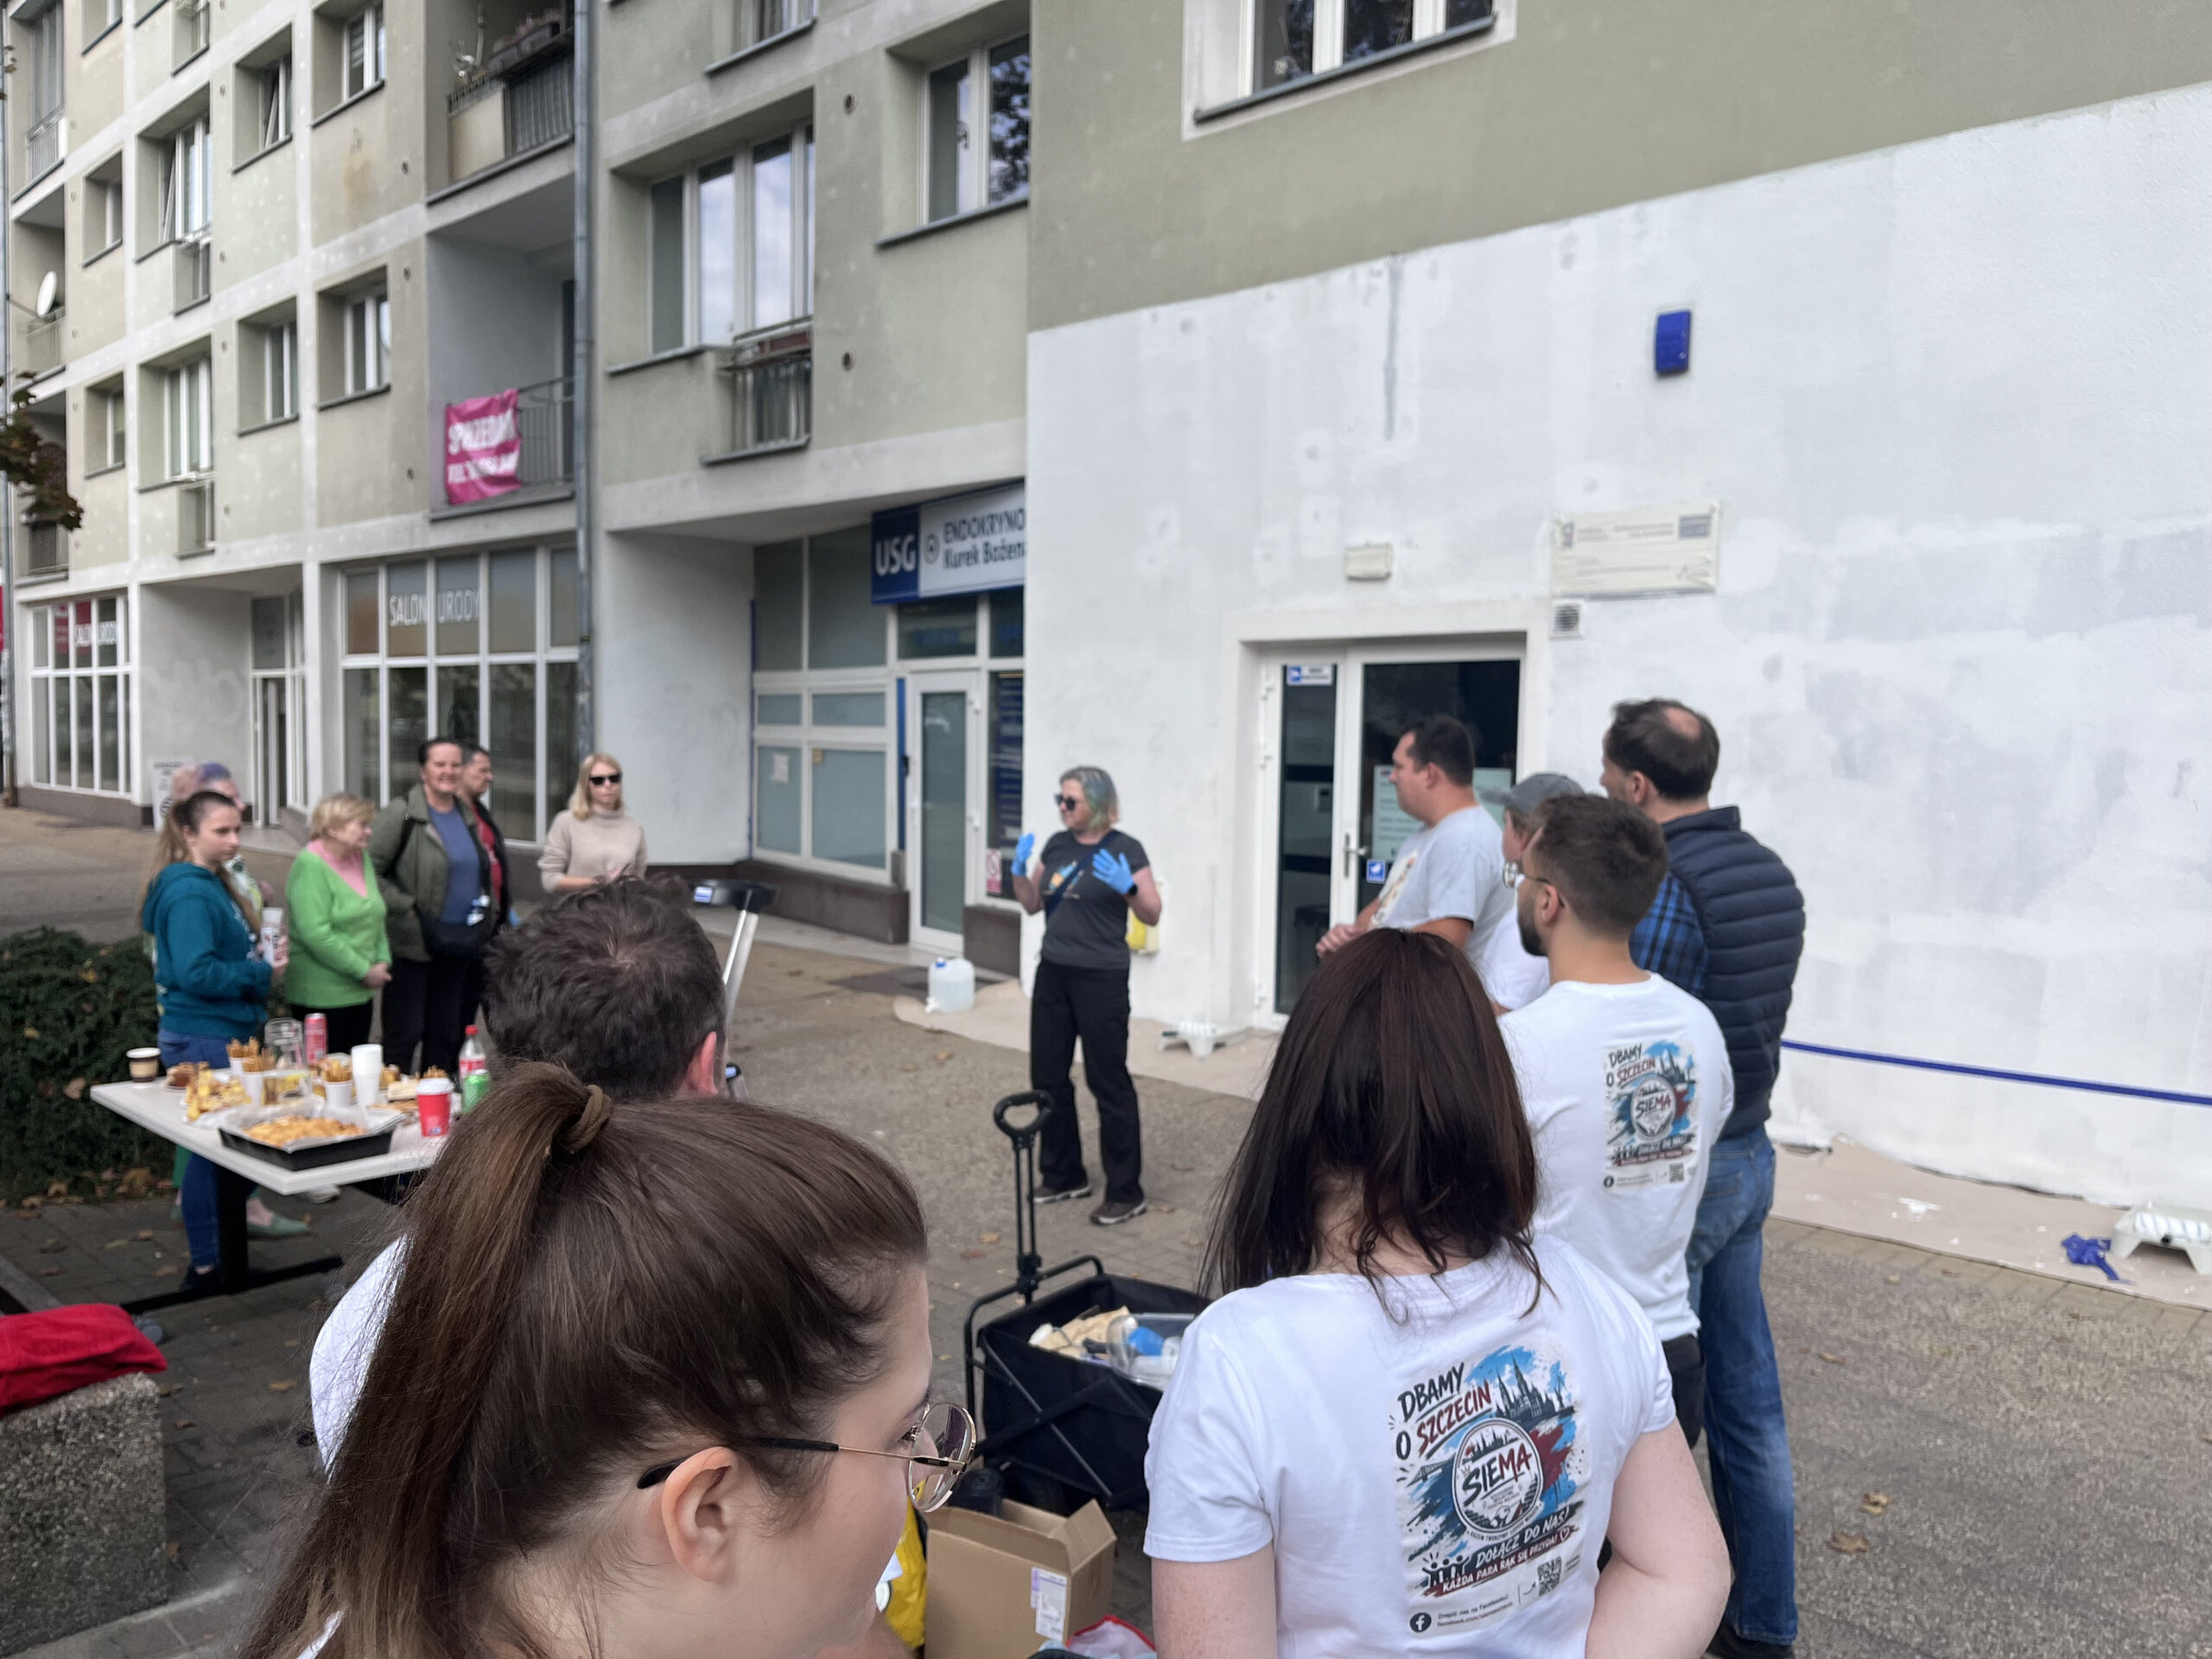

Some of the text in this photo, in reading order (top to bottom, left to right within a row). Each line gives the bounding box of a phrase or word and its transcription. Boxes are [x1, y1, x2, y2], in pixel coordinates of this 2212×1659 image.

[874, 534, 917, 577] USG
[1636, 1094, 1672, 1120] SIEMA
[1395, 1378, 1492, 1460] O SZCZECIN
[1397, 1362, 1465, 1422] DBAMY
[1462, 1442, 1532, 1508] SIEMA
[1475, 1535, 1520, 1568] DOŁĄCZ
[1523, 1524, 1540, 1544] DO
[1542, 1506, 1570, 1534] NAS!
[1442, 1573, 1474, 1593] KAŻDA
[1476, 1565, 1498, 1580] PARA
